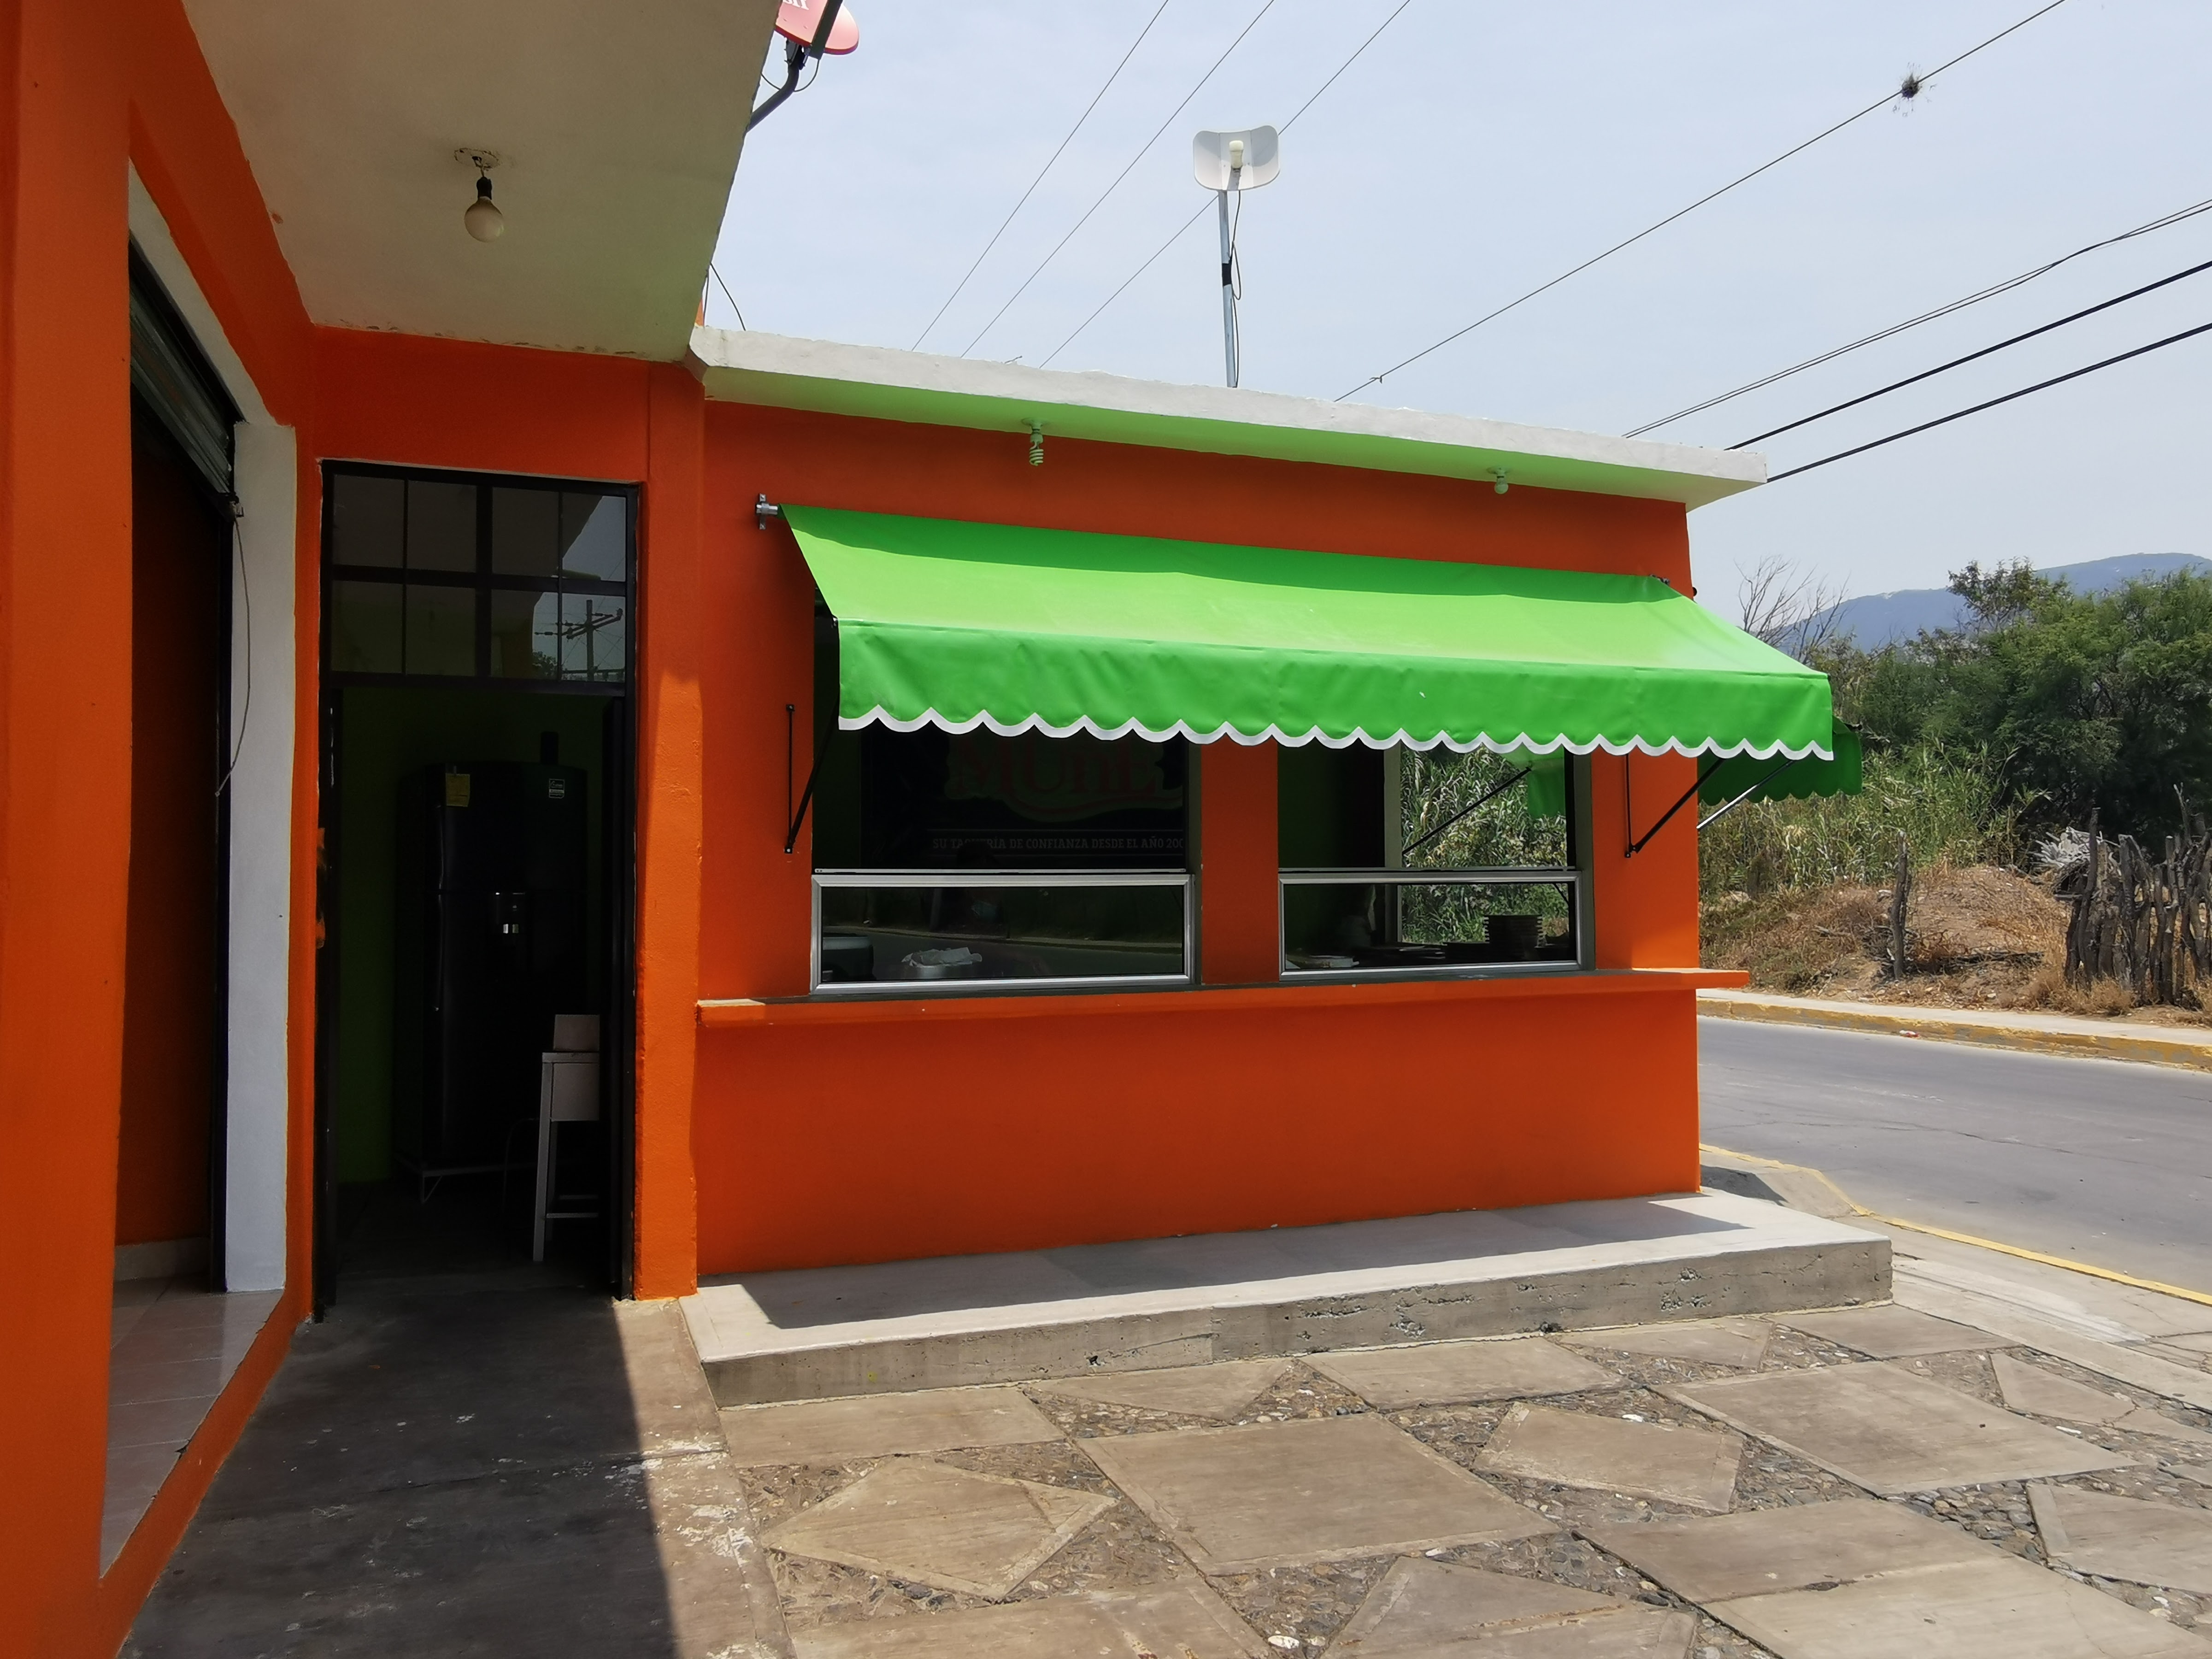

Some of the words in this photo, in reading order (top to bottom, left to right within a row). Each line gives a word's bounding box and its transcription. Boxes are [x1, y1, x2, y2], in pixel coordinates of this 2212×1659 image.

[933, 838, 947, 848] SU
[1009, 838, 1023, 848] DE
[1026, 838, 1089, 848] CONFIANZA
[1091, 838, 1124, 848] DESDE
[1126, 838, 1138, 848] EL
[1141, 835, 1164, 848] AÑO
